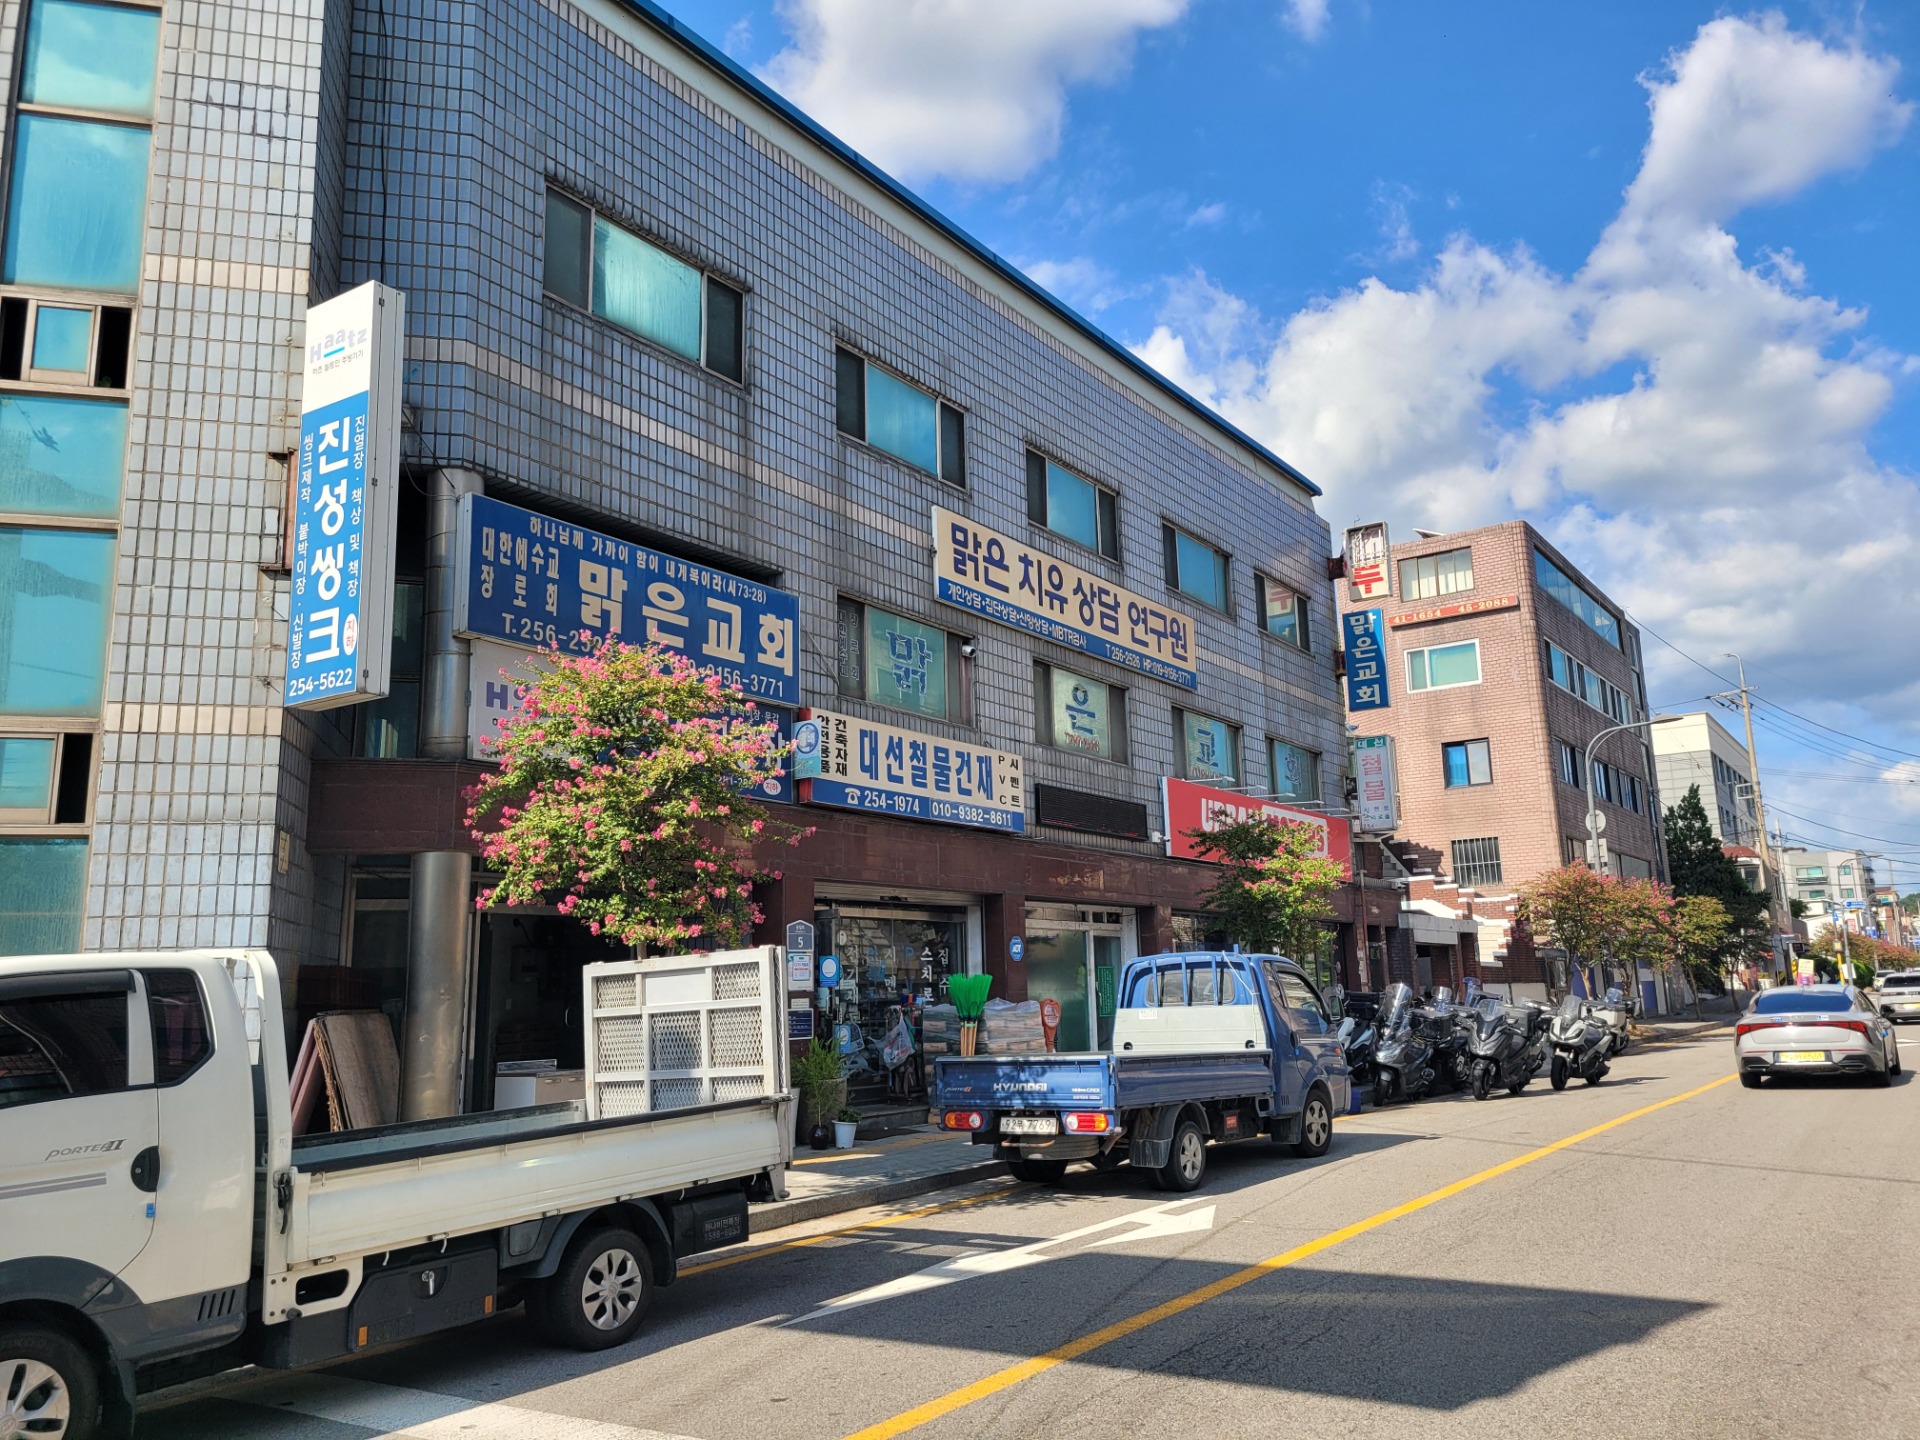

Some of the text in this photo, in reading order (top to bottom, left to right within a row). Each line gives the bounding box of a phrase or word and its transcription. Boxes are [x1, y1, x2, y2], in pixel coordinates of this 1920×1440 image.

[310, 328, 367, 364] Haatz
[347, 413, 365, 598] 진열장 책상 및 책장
[305, 416, 351, 664] 진성씽크
[481, 526, 560, 580] 대한예수교
[529, 515, 584, 546] 하나님께
[591, 534, 629, 564] 가까이
[636, 549, 659, 573] 함이
[951, 522, 1189, 663] 맑은 치유 상담 연구원
[1393, 597, 1509, 624] 41-1654 45-2088
[346, 618, 356, 650] 지하
[578, 559, 794, 677] 맑은교회
[1112, 647, 1141, 669] 256-2526
[1348, 612, 1382, 706] 맑은교회
[289, 667, 353, 697] 254-5622
[834, 718, 848, 777] 건축자재
[858, 728, 994, 801] 대선철물건재
[765, 781, 778, 793] 지하
[864, 789, 1012, 827] 254-1974 010-9382-8611
[797, 936, 804, 948] 5
[993, 1082, 1047, 1092] HYUNDAI
[1026, 1119, 1051, 1131] 7769
